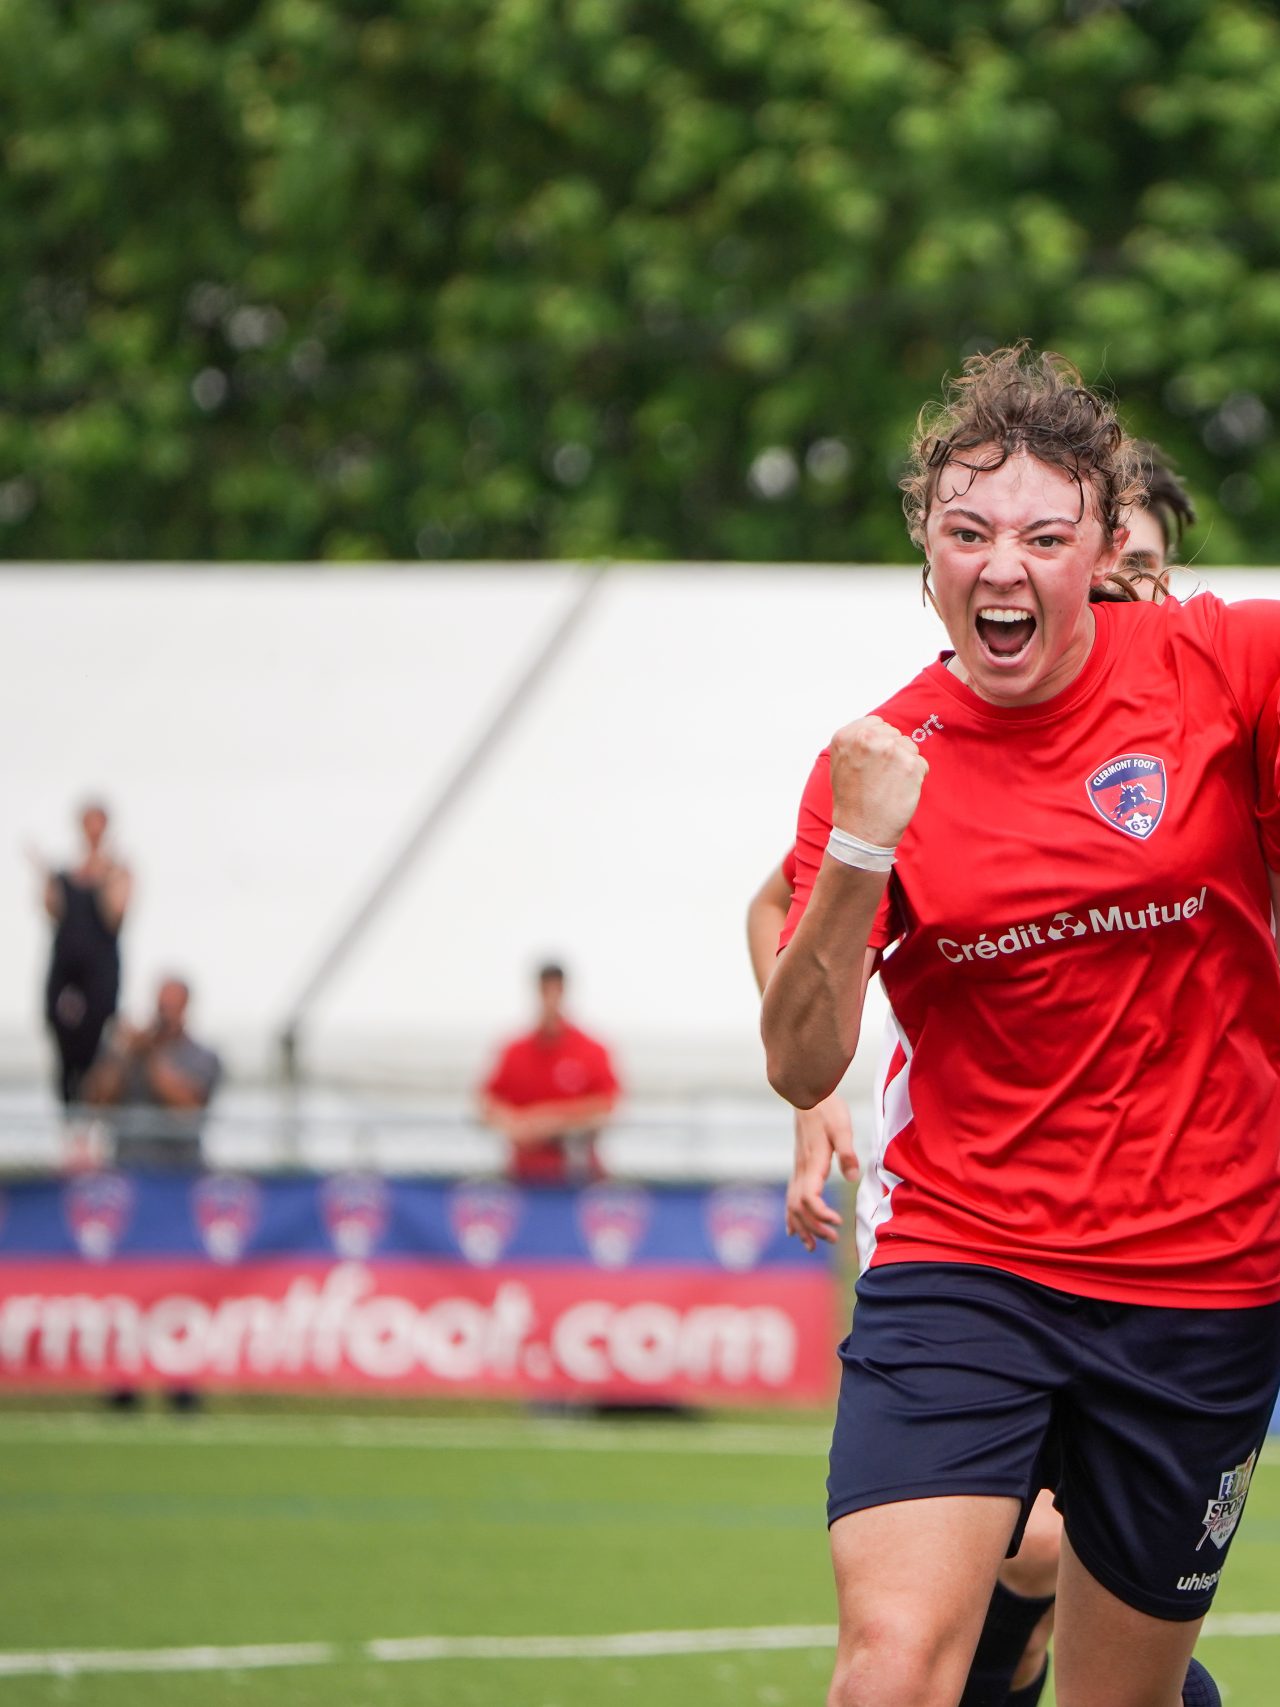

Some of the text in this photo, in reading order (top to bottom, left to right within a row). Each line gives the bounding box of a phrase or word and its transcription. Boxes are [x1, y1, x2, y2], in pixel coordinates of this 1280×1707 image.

[1093, 759, 1156, 786] CLERMONT FOOT
[1130, 818, 1150, 831] 63
[937, 886, 1207, 963] Crédit Mutuel
